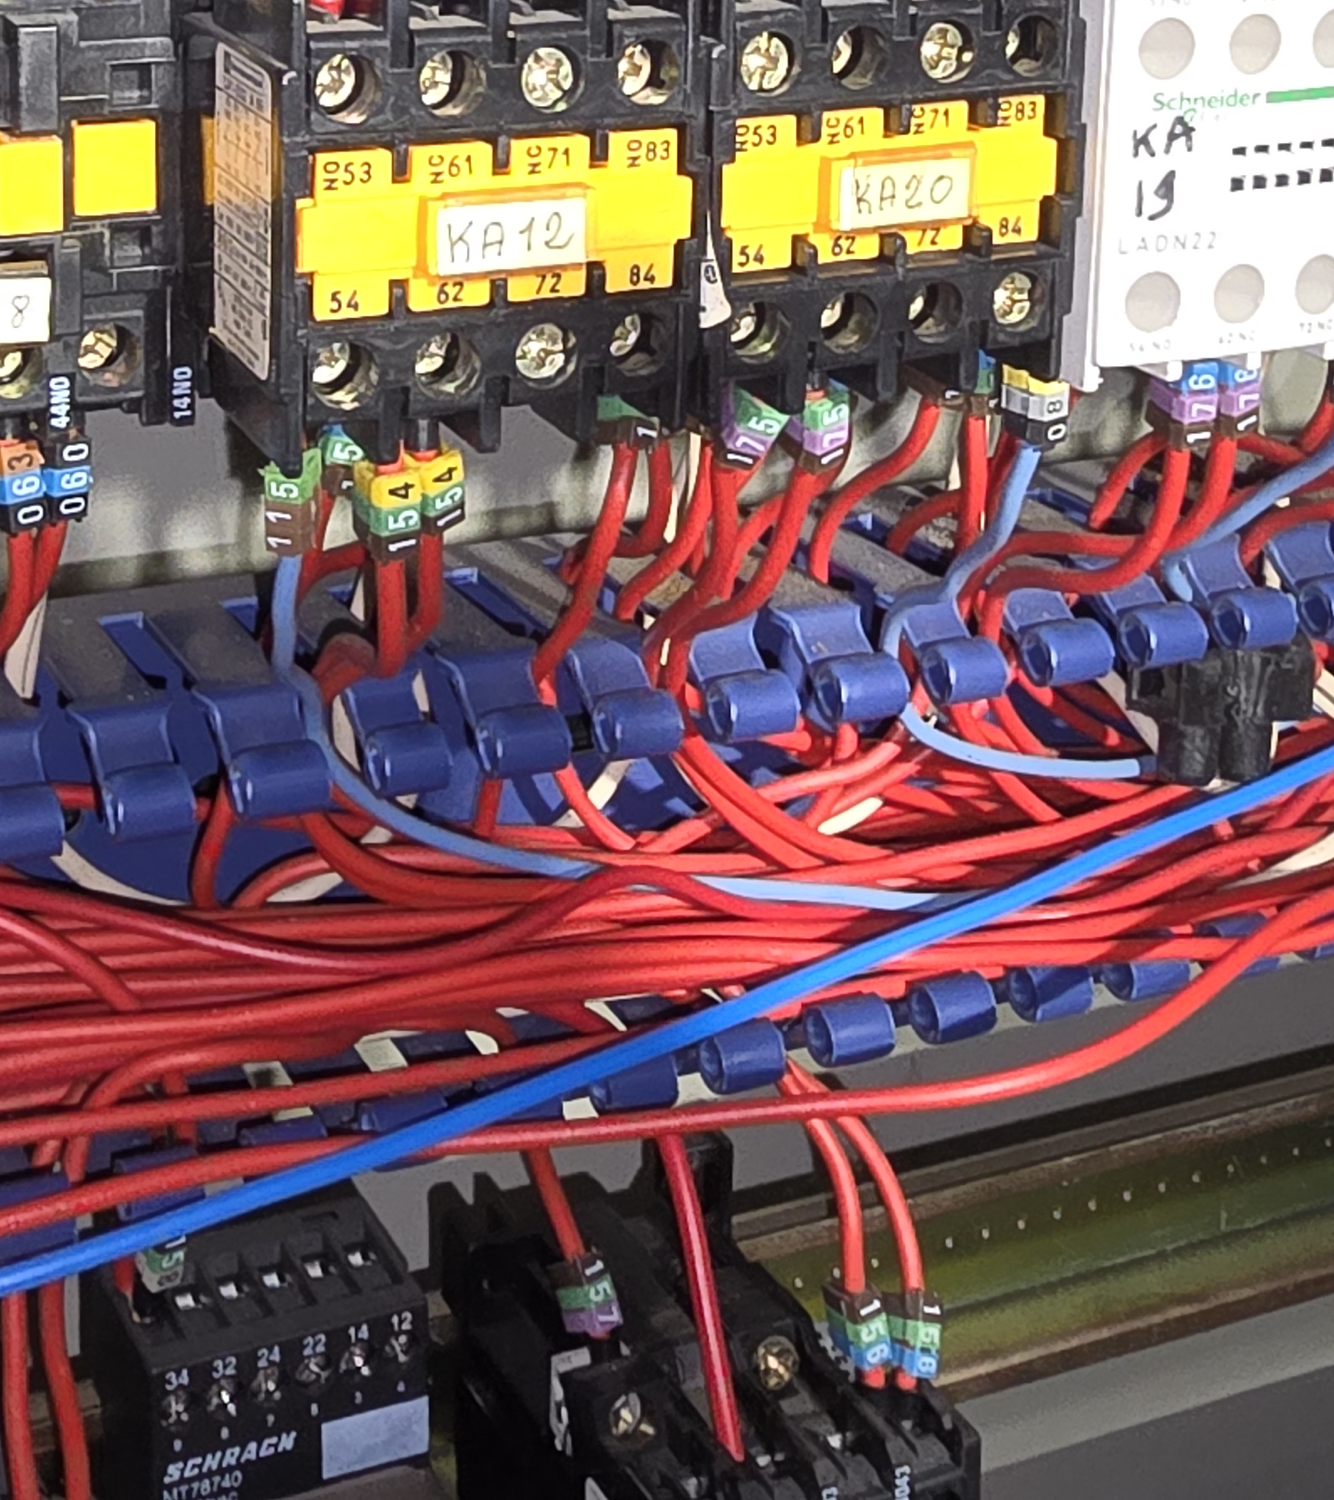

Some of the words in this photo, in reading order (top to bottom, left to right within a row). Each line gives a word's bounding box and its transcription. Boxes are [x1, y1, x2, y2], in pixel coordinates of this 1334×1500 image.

[1014, 100, 1038, 122] 83
[1152, 88, 1262, 112] Schneider
[826, 116, 842, 146] NC
[842, 115, 866, 138] 61
[911, 106, 926, 135] NC
[928, 106, 951, 130] 71
[751, 124, 777, 148] 53
[1132, 116, 1196, 158] KA
[526, 144, 543, 176] NC
[547, 146, 572, 169] 71
[626, 139, 643, 169] NO
[645, 139, 672, 162] 83
[323, 161, 341, 191] NO
[342, 162, 373, 186] 53
[427, 154, 446, 185] NC
[448, 154, 474, 178] 61
[853, 173, 954, 216] KA20
[446, 211, 575, 264] KA12
[998, 215, 1023, 238] 84
[737, 243, 766, 268] 54
[830, 234, 857, 257] 62
[1116, 231, 1219, 255] LADN22
[534, 272, 562, 295] 72
[628, 263, 657, 287] 84
[329, 290, 360, 314] 54
[436, 281, 465, 305] 62
[48, 375, 71, 430] 44NO
[172, 365, 193, 419] 14NO
[347, 1322, 370, 1344] 14
[390, 1310, 414, 1333] 12
[256, 1344, 282, 1369] 24
[302, 1332, 328, 1357] 22
[164, 1367, 190, 1392] 34
[211, 1355, 238, 1380] 32
